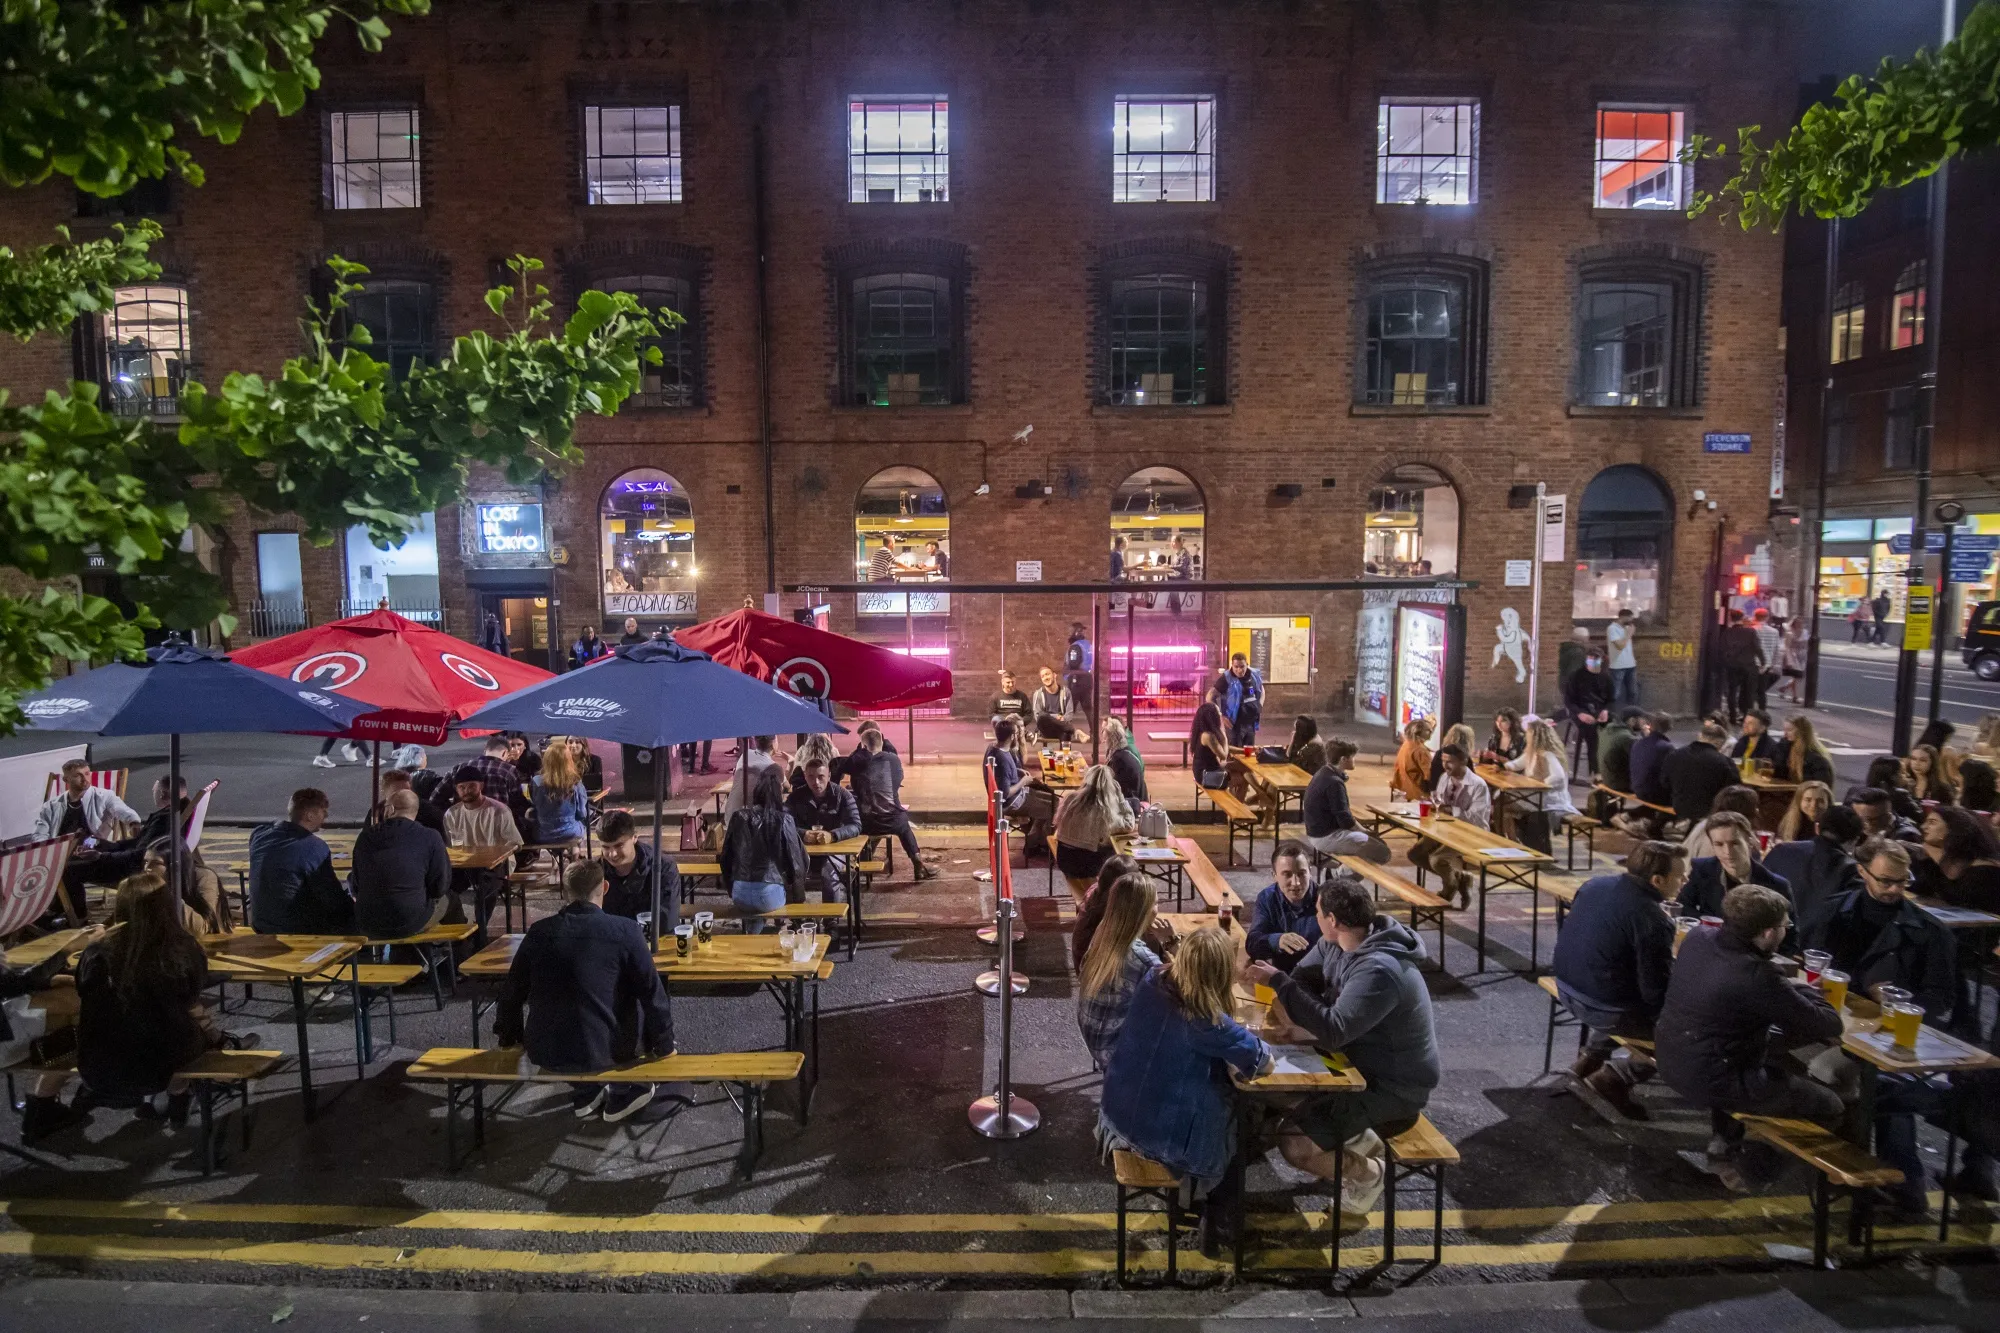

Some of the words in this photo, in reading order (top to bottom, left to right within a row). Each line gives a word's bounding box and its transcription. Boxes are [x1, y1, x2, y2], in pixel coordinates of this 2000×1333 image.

[1705, 434, 1751, 442] STEVENSON
[1711, 442, 1744, 451] SQUARE
[481, 506, 519, 521] LOST
[483, 521, 500, 536] IN
[485, 535, 538, 550] TOKYO
[622, 594, 672, 613] LOADING
[559, 697, 621, 711] FRANKLIN
[563, 709, 587, 717] SONS
[359, 719, 389, 729] TOWN
[392, 721, 442, 734] BREWERY
